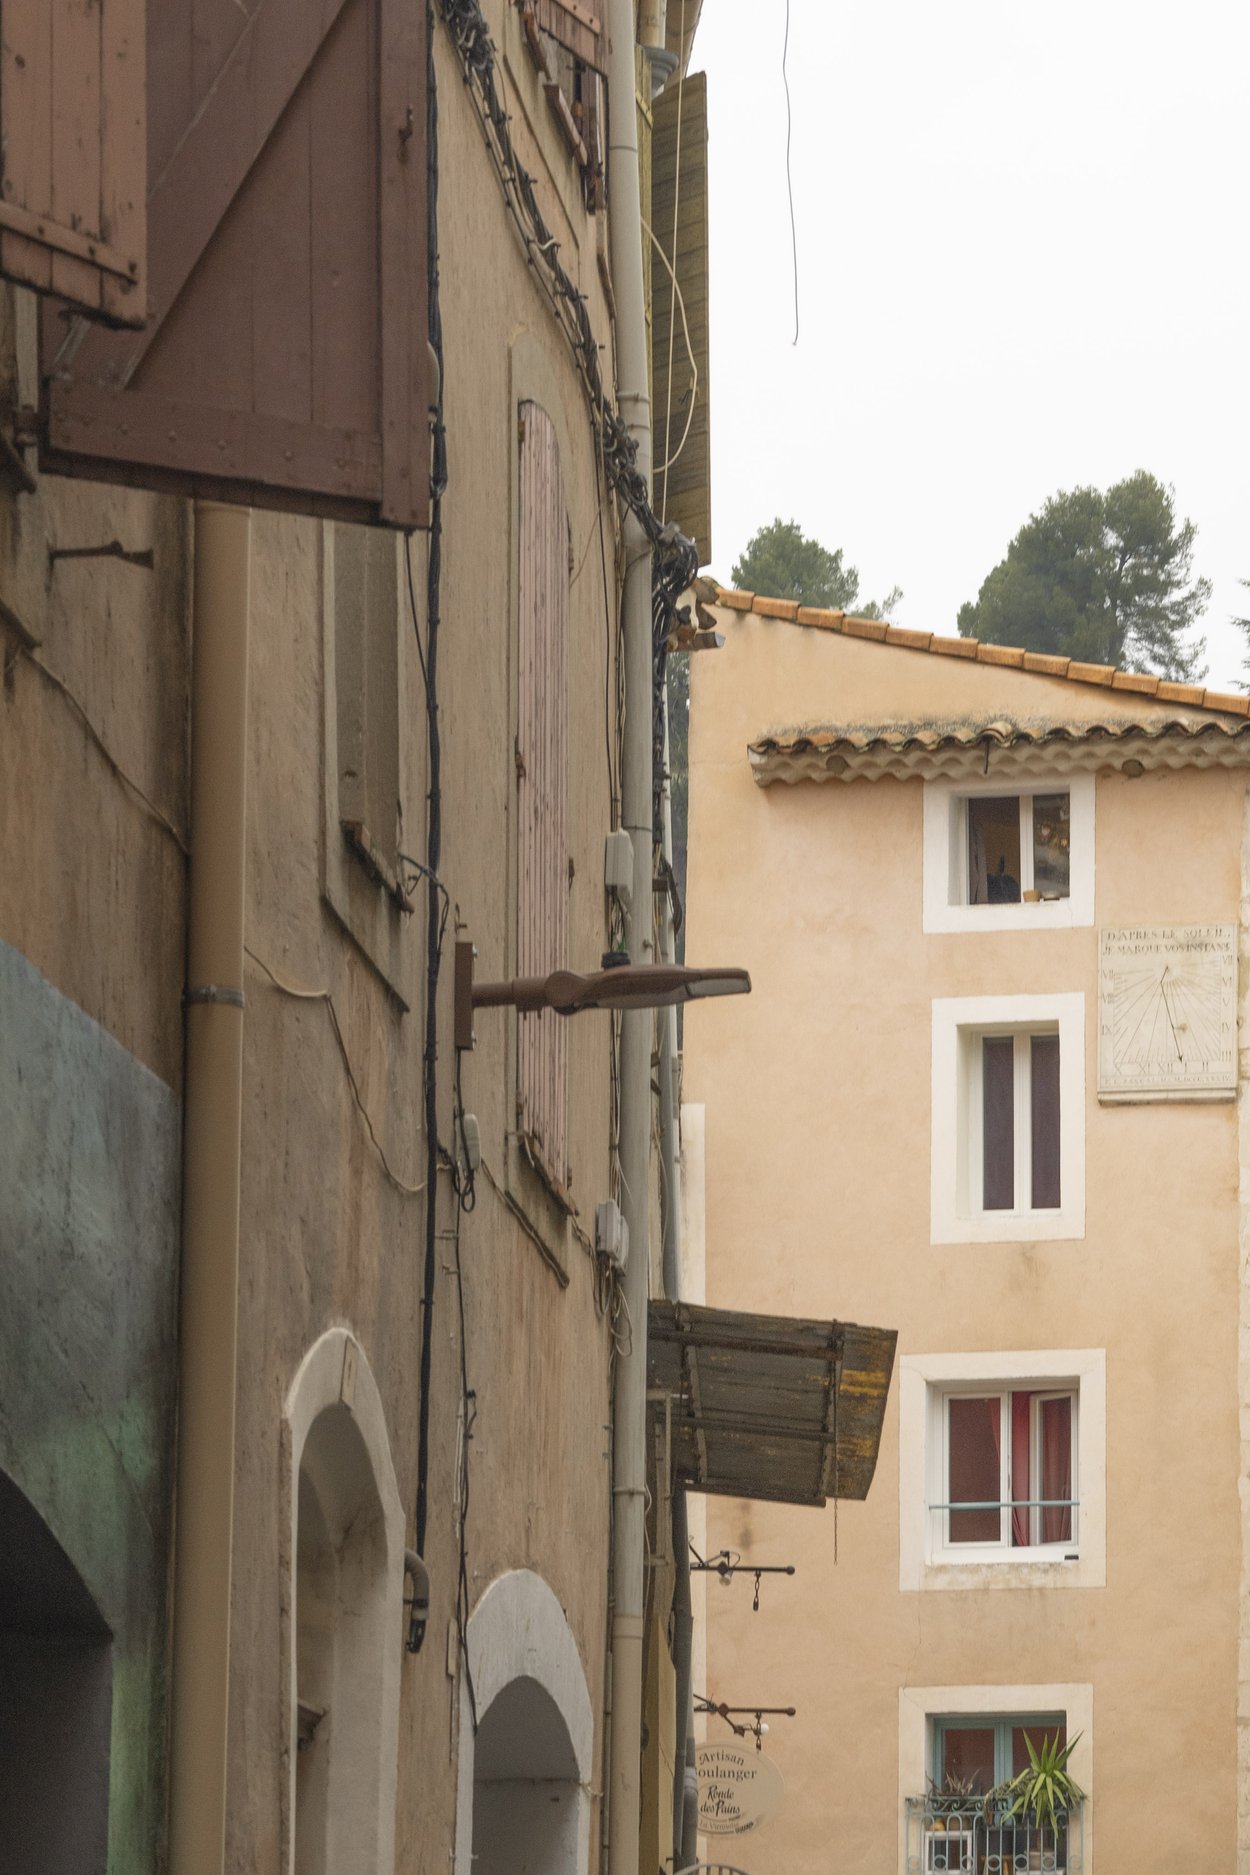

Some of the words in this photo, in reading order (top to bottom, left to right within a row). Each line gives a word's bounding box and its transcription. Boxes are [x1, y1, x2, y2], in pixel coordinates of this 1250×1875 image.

[700, 1750, 744, 1766] Artisan
[696, 1766, 757, 1782] oulanger
[708, 1785, 734, 1802] Ronde
[700, 1802, 714, 1813] des
[714, 1800, 740, 1816] Pains
